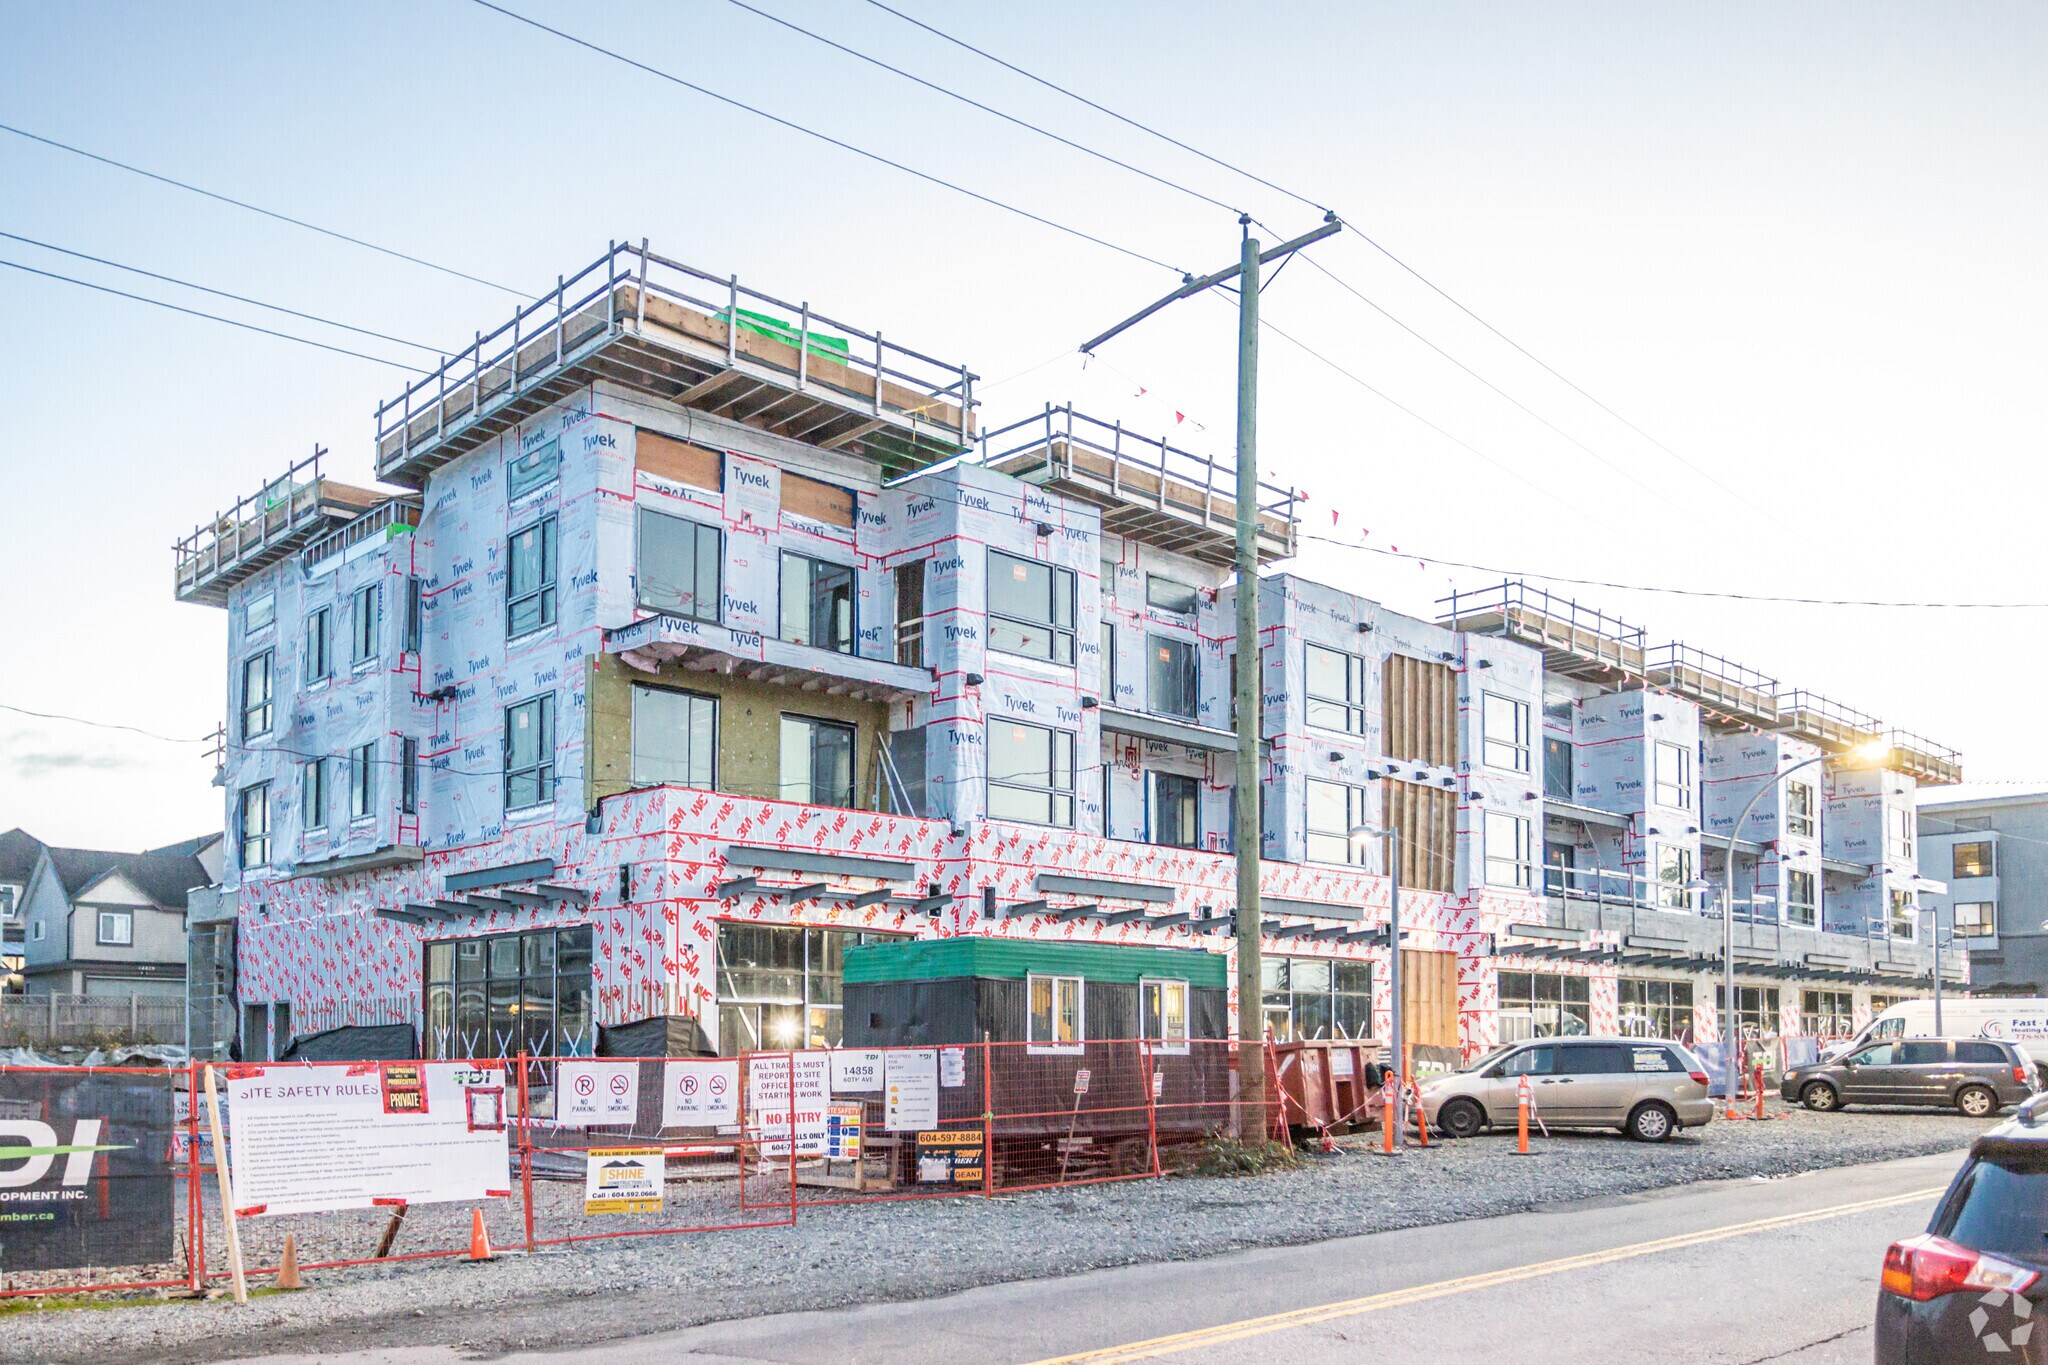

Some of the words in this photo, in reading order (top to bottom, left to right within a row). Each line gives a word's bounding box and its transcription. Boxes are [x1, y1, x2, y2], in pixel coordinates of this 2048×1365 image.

[562, 407, 586, 430] Tyvek
[522, 428, 545, 450] Tyvek
[583, 434, 616, 452] Tyvek
[471, 468, 492, 490] Tyvek
[733, 467, 770, 490] Tyvek
[907, 498, 935, 517] Tyvek
[957, 489, 989, 510] Tyvek
[857, 506, 886, 525] Tyvek
[452, 558, 473, 578] Tyvek
[934, 555, 964, 575] Tyvek
[572, 570, 598, 590] Tyvek
[452, 581, 472, 600] Tyvek
[722, 594, 757, 617] Tyvek
[1295, 599, 1316, 615] Tyvek
[1330, 609, 1350, 624] Tyvek
[616, 624, 642, 642] Tyvek
[658, 616, 699, 636] Tyvek
[944, 626, 976, 643] Tyvek
[1393, 636, 1412, 650] Tyvek
[469, 656, 490, 673] Tyvek
[434, 668, 454, 686] Tyvek
[534, 666, 557, 685] Tyvek
[456, 684, 475, 700] Tyvek
[496, 681, 518, 700] Tyvek
[356, 692, 373, 709] Tyvek
[1004, 695, 1035, 713] Tyvek
[1263, 694, 1290, 707] Tyvek
[327, 704, 343, 718] Tyvek
[1619, 705, 1645, 719] Tyvek
[299, 713, 315, 729] Tyvek
[431, 732, 449, 747] Tyvek
[949, 729, 981, 746] Tyvek
[1145, 740, 1168, 752] Tyvek
[465, 747, 485, 764] Tyvek
[1185, 748, 1206, 759] Tyvek
[1742, 749, 1766, 760] Tyvek
[431, 757, 450, 773] Tyvek
[1615, 779, 1642, 790] Tyvek
[1843, 785, 1866, 794] Tyvek
[633, 811, 644, 833] 3M
[669, 806, 687, 830] 3M
[1710, 816, 1733, 827] Tyvek
[1750, 813, 1775, 823] Tyvek
[481, 822, 501, 837] Tyvek
[737, 816, 752, 839] 3M
[776, 820, 792, 842] 3M
[814, 824, 829, 847] 3M
[446, 831, 465, 844] Tyvek
[667, 833, 686, 858] 3M
[849, 828, 864, 850] 3M
[900, 833, 912, 855] 3M
[1844, 839, 1867, 848] Tyvek
[932, 837, 944, 858] 3M
[993, 840, 1007, 860] 3M
[1022, 844, 1035, 864] 3M
[1050, 846, 1063, 865] 3M
[1107, 852, 1118, 871] 3M
[948, 875, 961, 895] 3M
[1008, 878, 1021, 898] 3M
[1853, 882, 1876, 891] Tyvek
[749, 896, 766, 919] 3M
[827, 900, 843, 922] 3M
[612, 918, 625, 937] 3M
[966, 909, 979, 930] 3M
[1029, 918, 1043, 937] 3M
[1463, 916, 1474, 933] 3M
[1833, 923, 1856, 932] Tyvek
[652, 929, 665, 950] 3M
[1463, 942, 1476, 957] 3M
[454, 1071, 491, 1084] TDI
[844, 1067, 874, 1075] 14358
[240, 1087, 272, 1099] SITE
[277, 1085, 331, 1098] SAFETY
[336, 1084, 378, 1096] RULES
[390, 1092, 420, 1108] PRIVATE
[759, 1091, 797, 1099] STARTING
[766, 1113, 782, 1125] NO
[786, 1112, 821, 1123] ENTRY
[772, 1142, 818, 1150] 604-74-4080
[920, 1133, 981, 1142] 604-597-8884
[608, 1169, 644, 1180] SHINE
[62, 1190, 88, 1200] INC.
